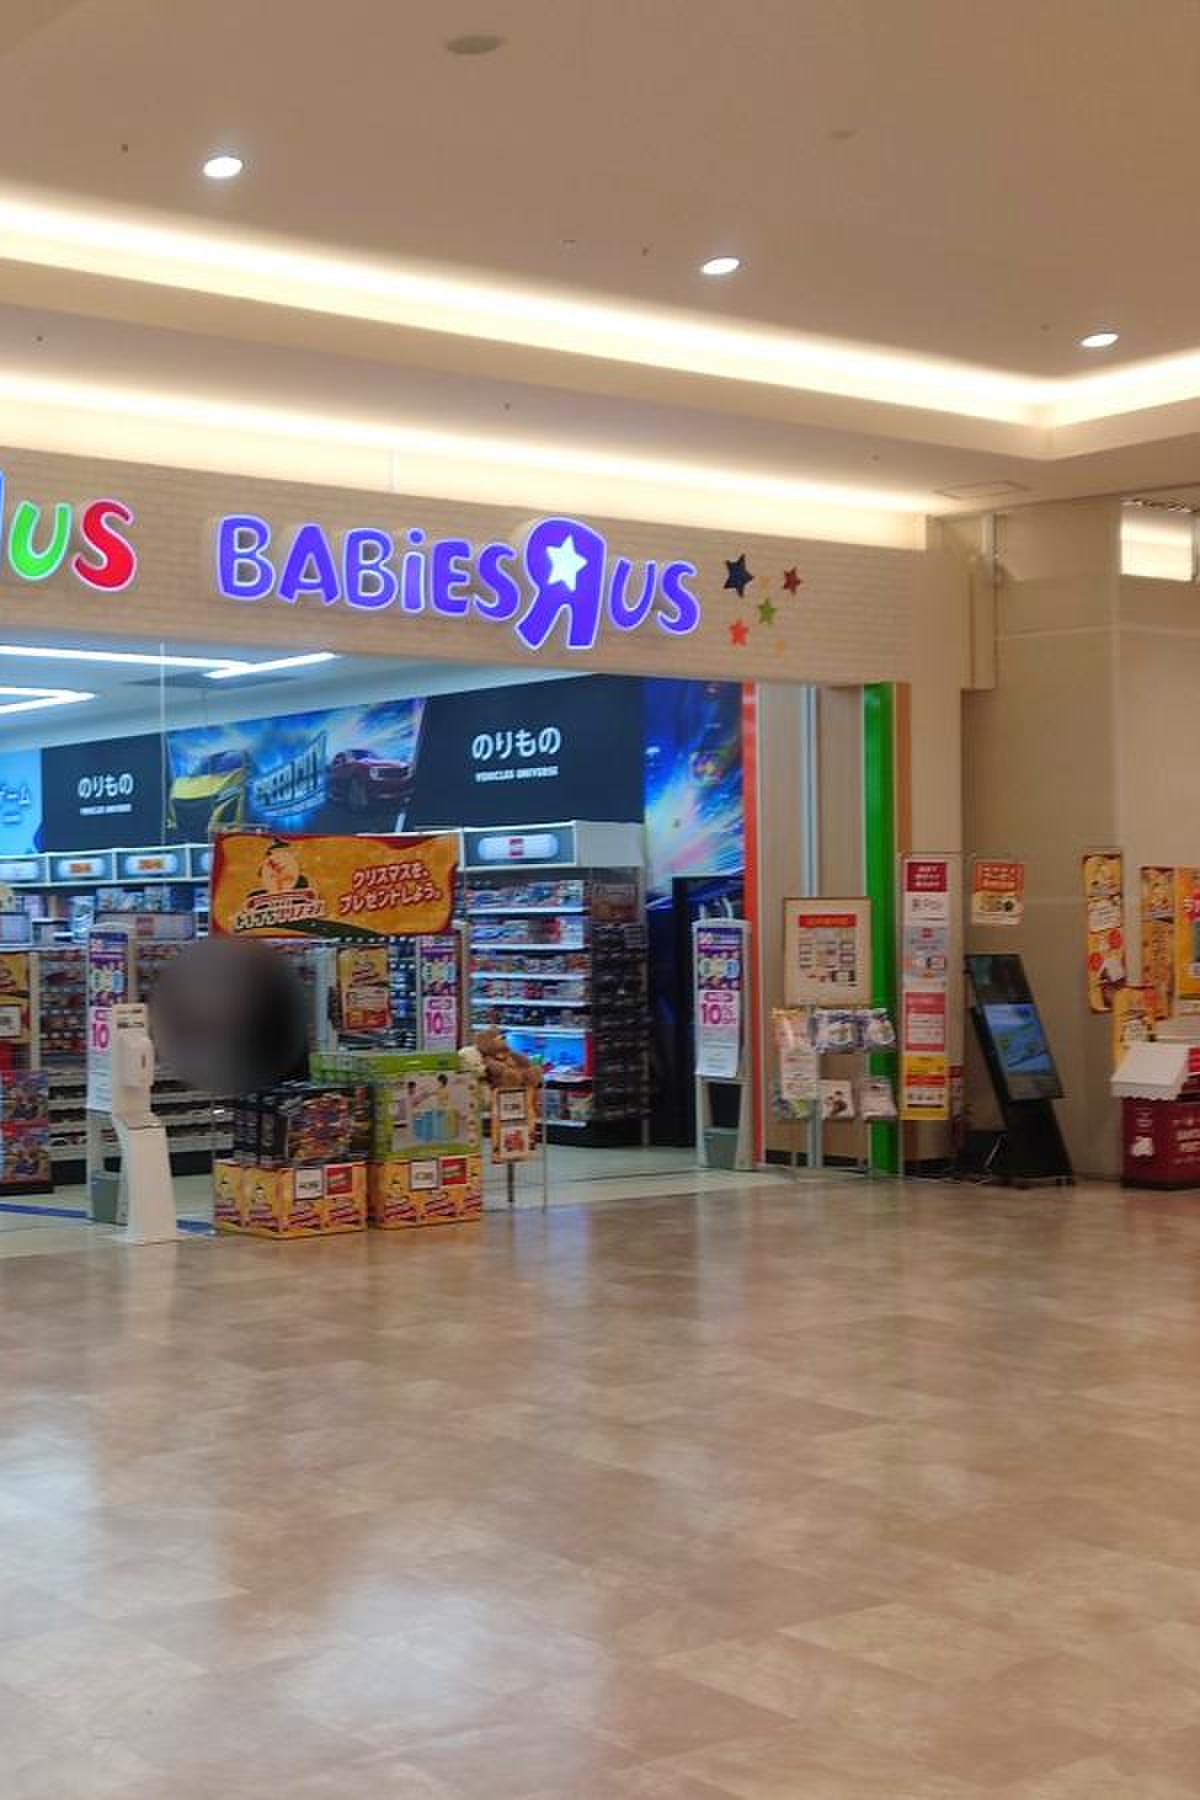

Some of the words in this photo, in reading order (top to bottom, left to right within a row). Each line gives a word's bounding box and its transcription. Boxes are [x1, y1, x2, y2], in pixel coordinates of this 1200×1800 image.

[471, 727, 561, 760] のりもの
[78, 773, 134, 799] のりもの
